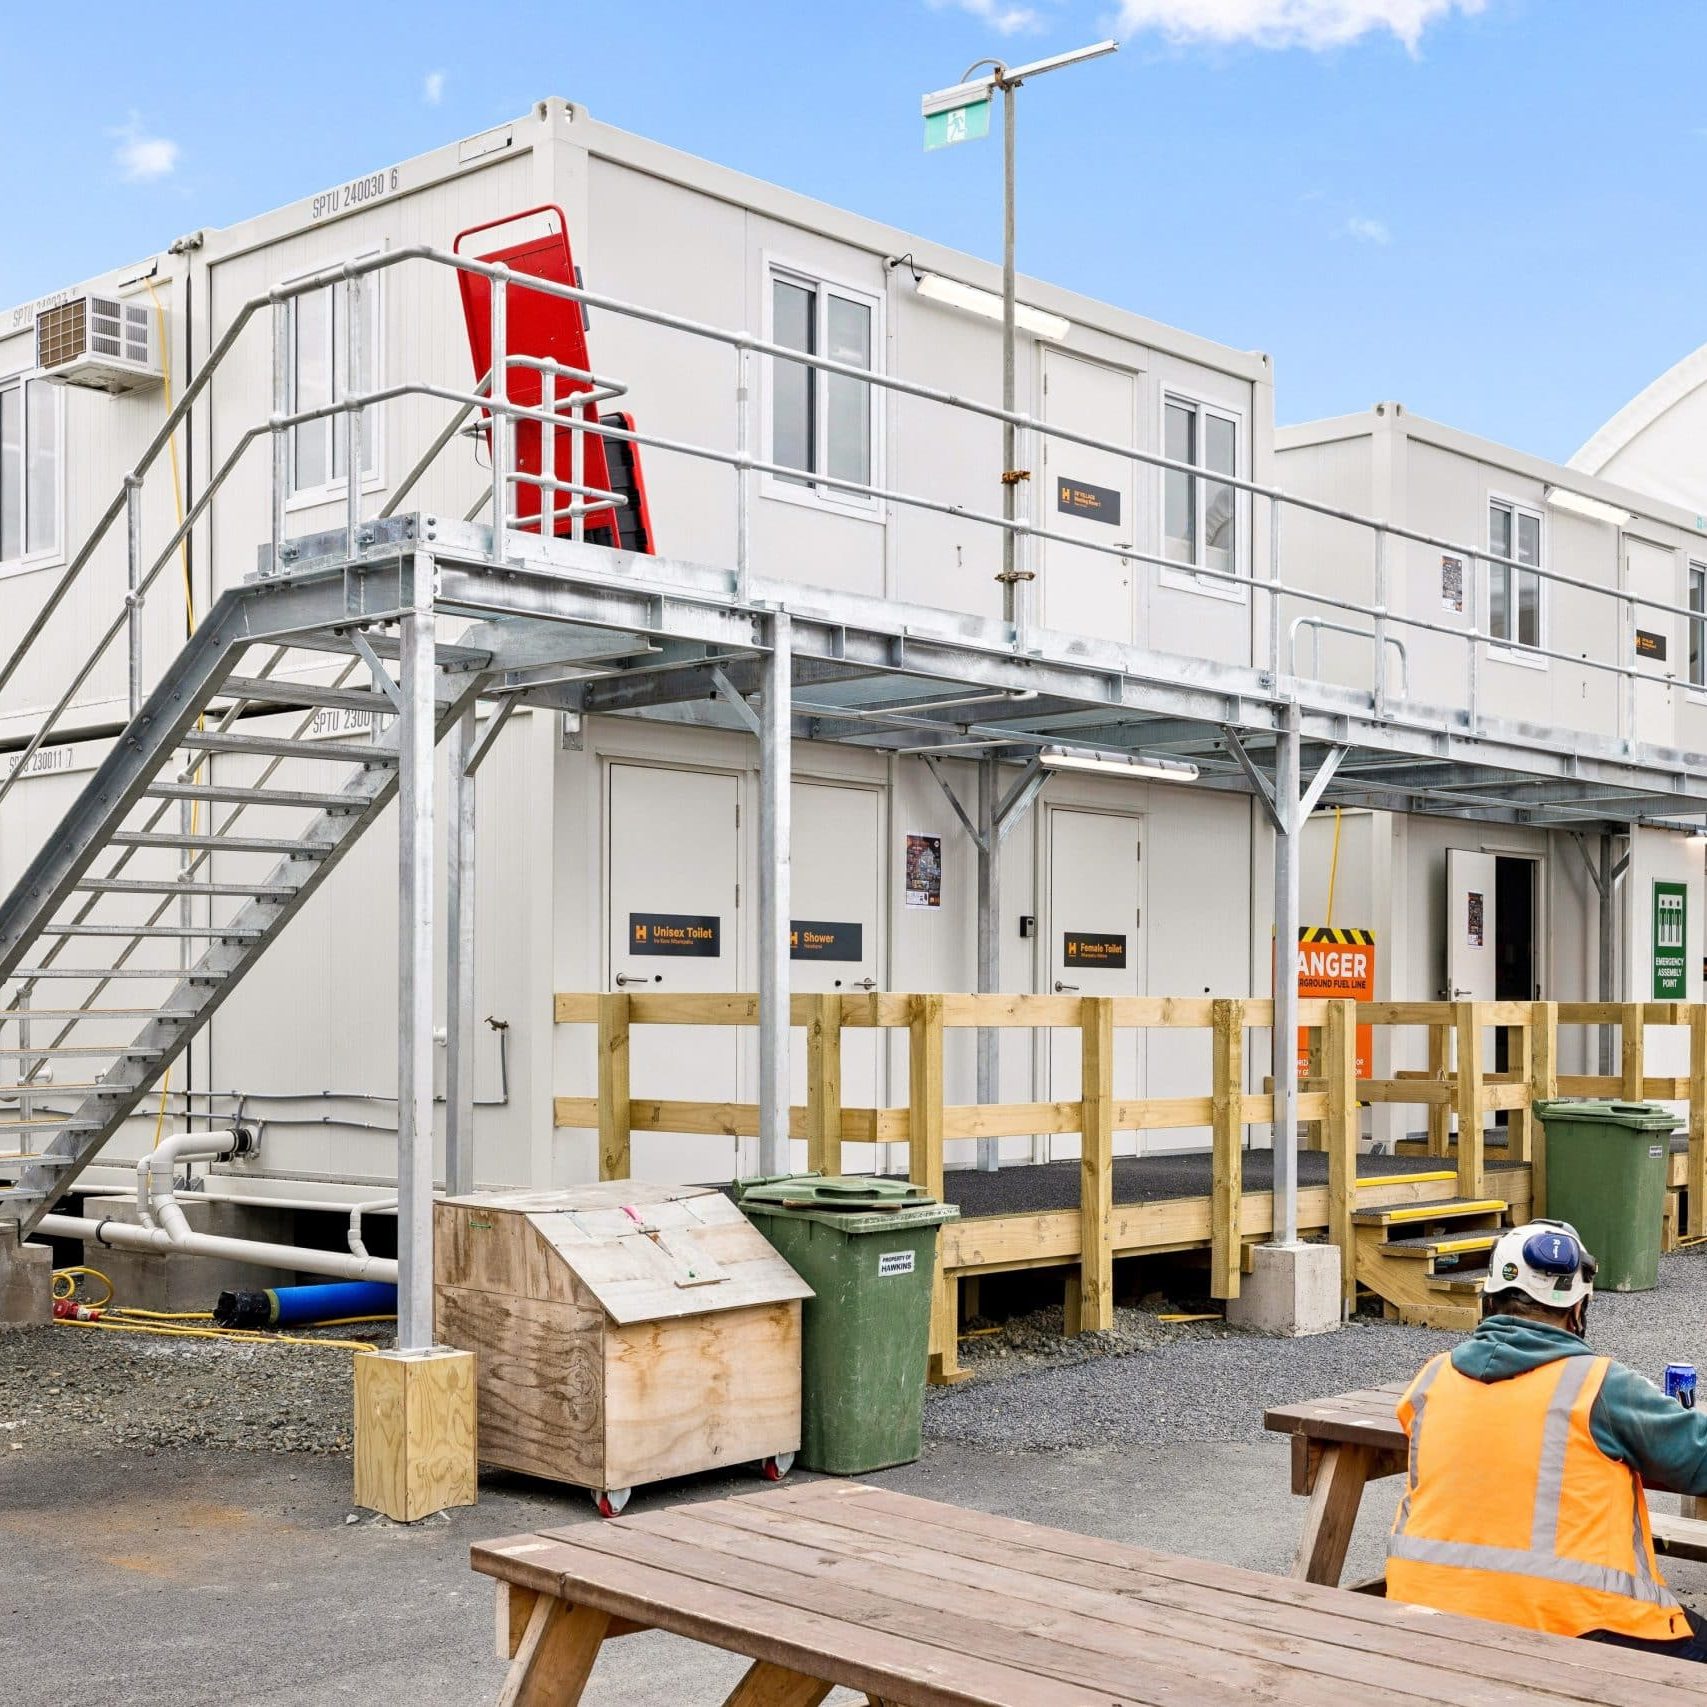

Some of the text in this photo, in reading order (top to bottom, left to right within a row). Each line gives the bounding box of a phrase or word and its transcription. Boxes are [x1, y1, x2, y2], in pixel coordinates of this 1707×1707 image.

[312, 168, 399, 218] SPTU 240030 6
[312, 708, 371, 734] SPTU 2300
[32, 750, 62, 771] 230011
[66, 747, 73, 767] 7
[653, 926, 684, 937] Unisex
[687, 927, 713, 939] Toilet
[803, 931, 835, 943] Shower
[1080, 942, 1104, 953] Female
[1104, 944, 1122, 954] Toilet
[1297, 951, 1367, 978] ANGER
[1655, 957, 1685, 966] EMERGENCY
[1657, 968, 1682, 977] ASSEMBLY
[1298, 979, 1366, 989] RGROUND FUEL LINE
[1662, 979, 1677, 988] POINT
[881, 1262, 912, 1272] HAWKINS
